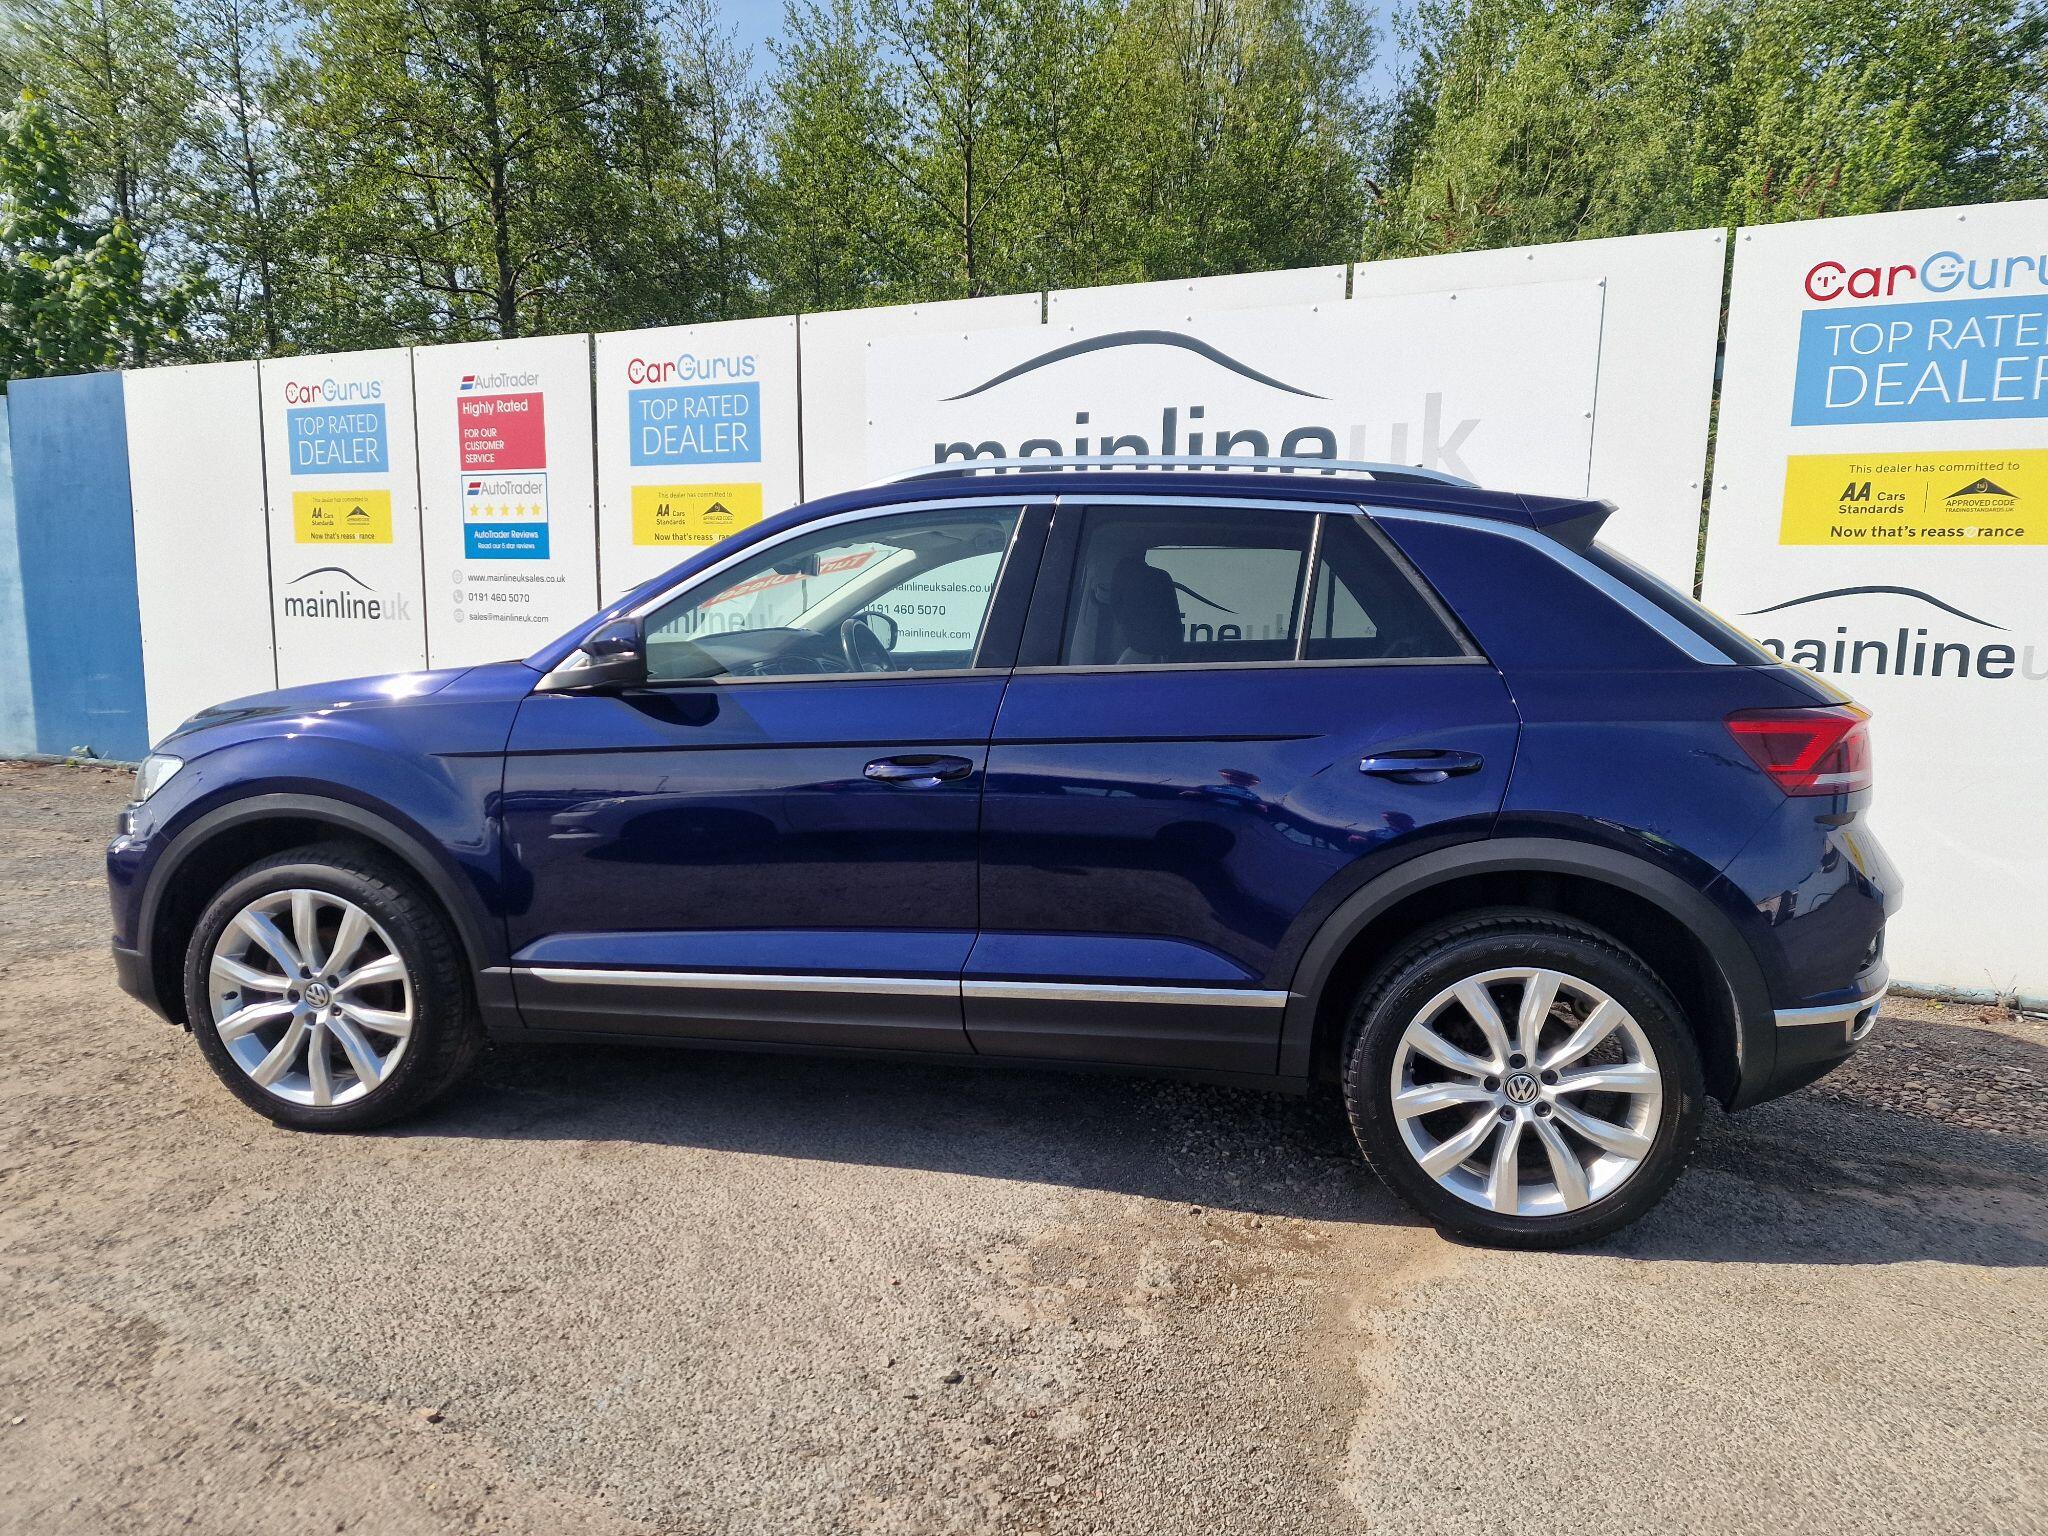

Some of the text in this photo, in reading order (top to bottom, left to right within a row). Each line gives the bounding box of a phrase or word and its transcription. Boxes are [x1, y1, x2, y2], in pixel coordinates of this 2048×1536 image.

[1825, 313, 2048, 356] TOP RATE
[628, 353, 756, 385] CarGurus
[474, 371, 539, 389] AutoTrader
[285, 378, 381, 404] CarGurus
[462, 398, 528, 417] Highly Rated
[639, 394, 749, 421] TOP RATED
[295, 413, 378, 435] TOP RATED
[464, 427, 497, 438] FOR OUR
[643, 422, 750, 455] DEALER
[298, 437, 380, 465] DEALER
[464, 440, 504, 451] CUSTOMER
[465, 453, 495, 463] SERVICE
[1849, 462, 2020, 474] This dealer has committed to
[480, 481, 542, 495] AutoTrader
[1839, 482, 1906, 501] AA Cars
[1838, 504, 1904, 514] Standards
[1945, 499, 1991, 507] APPROVED
[311, 507, 322, 518] AA
[656, 503, 670, 517] AA
[311, 532, 324, 540] Now
[511, 530, 539, 539] Reviews
[654, 533, 670, 541] Now
[1830, 526, 1867, 538] Now
[467, 573, 566, 583] www.mainlineuksales.co.uk
[468, 592, 530, 603] 0191 460 5070
[284, 590, 410, 620] mainlineuk
[893, 604, 914, 615] 460
[917, 605, 946, 615] 5070
